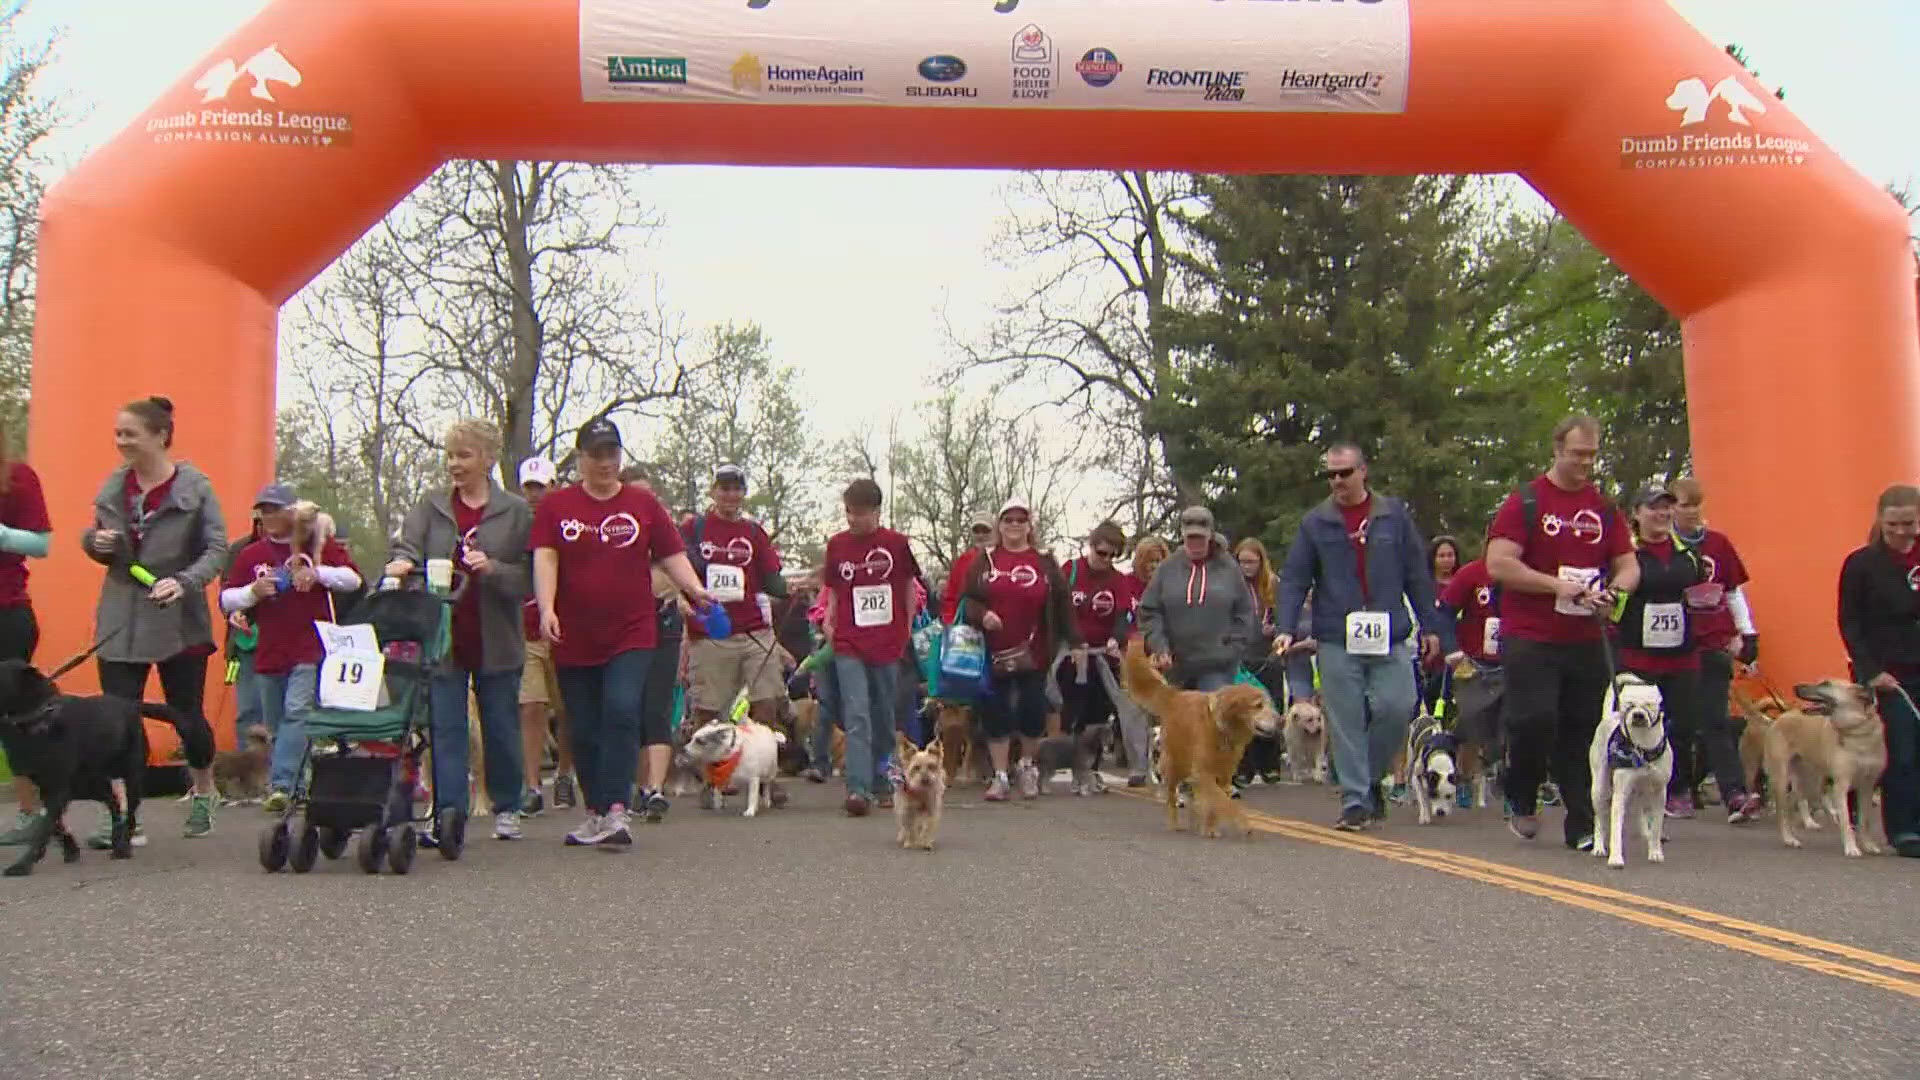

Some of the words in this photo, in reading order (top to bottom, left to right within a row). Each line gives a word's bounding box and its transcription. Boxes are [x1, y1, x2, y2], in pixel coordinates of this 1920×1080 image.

[611, 56, 684, 78] Amica
[767, 64, 864, 84] HomeAgain
[1013, 67, 1051, 78] FOOD
[1013, 79, 1049, 89] SHELTER
[1146, 68, 1244, 87] FRONTLINE
[1280, 69, 1369, 93] Heartgard
[905, 86, 978, 98] SUBARU
[1021, 89, 1049, 99] LOVE
[146, 111, 196, 132] Dumb
[199, 109, 273, 127] Friends
[277, 111, 347, 135] League
[153, 131, 253, 144] COMPASSION
[259, 133, 319, 146] ALWAYS
[1620, 136, 1678, 154] Dumb
[1683, 133, 1752, 150] Friends
[1755, 134, 1810, 155] League
[1635, 155, 1734, 169] COMPASSION
[1740, 154, 1794, 166] ALWAYS
[859, 595, 887, 611] 202
[1353, 621, 1382, 639] 248
[1650, 614, 1679, 632] 255
[337, 661, 364, 685] 19
